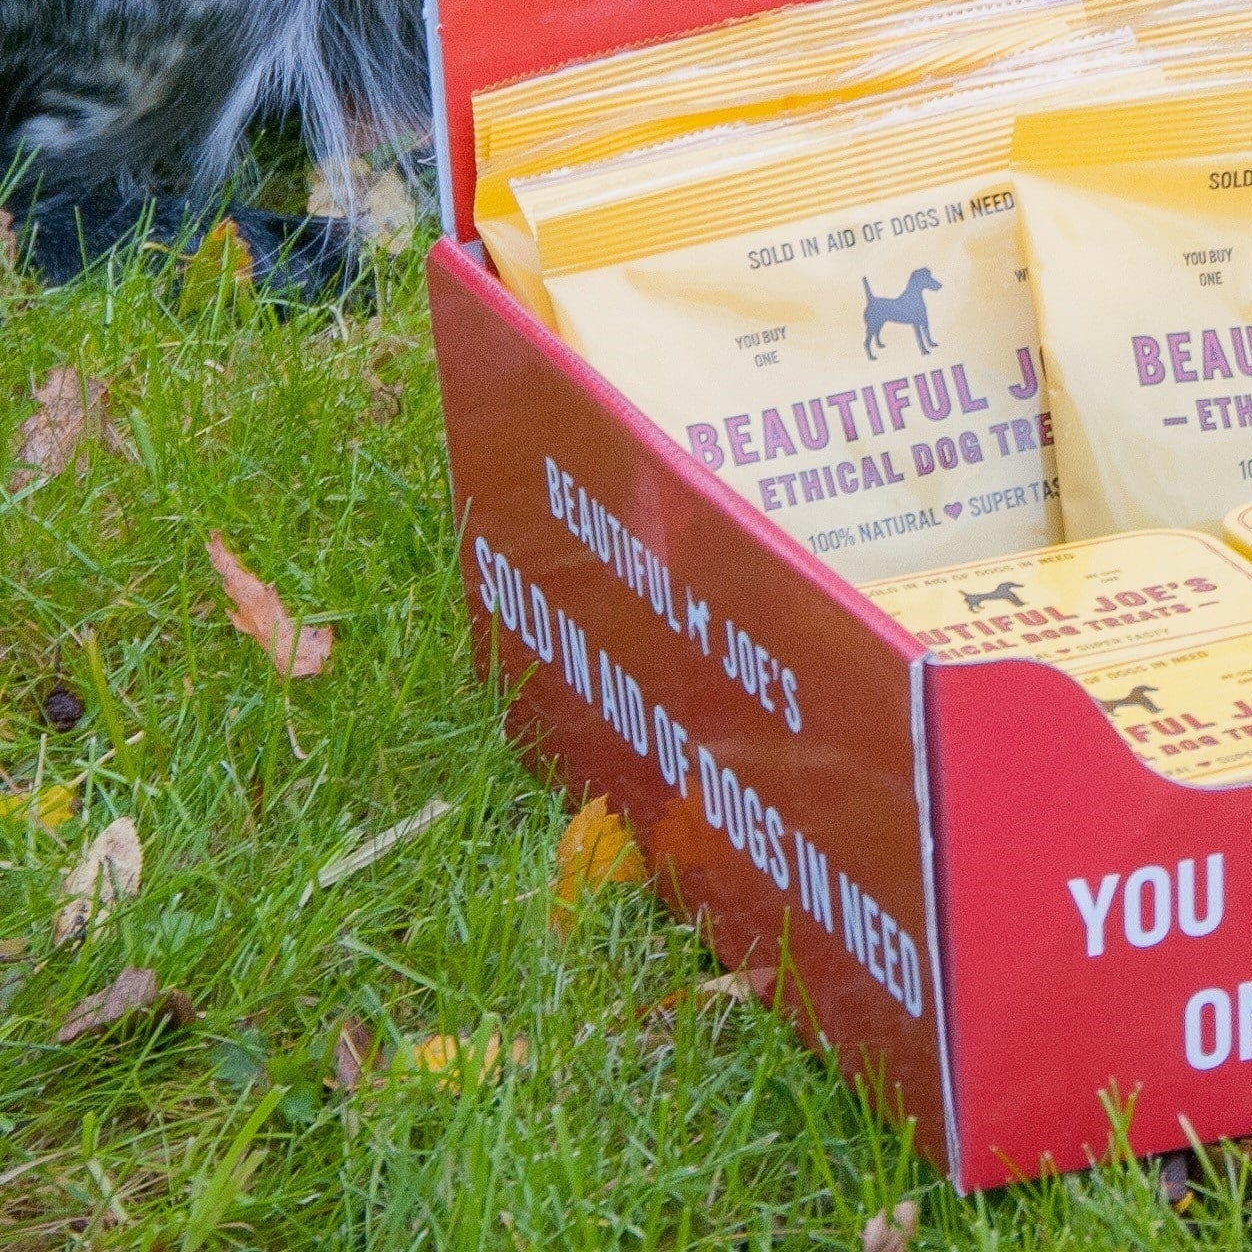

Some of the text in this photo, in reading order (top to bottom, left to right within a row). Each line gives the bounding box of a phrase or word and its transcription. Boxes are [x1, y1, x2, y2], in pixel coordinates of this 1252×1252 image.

[747, 190, 1016, 270] SOLD IN AID OF DOGS IN NEED
[1182, 247, 1234, 267] YOU BUY
[1198, 270, 1223, 287] ONE
[734, 326, 787, 351] YOU BUY
[754, 350, 780, 368] ONE
[685, 363, 989, 474] BEAUTIFUL
[757, 411, 1054, 512] ETHICAL DOG TRE
[807, 528, 855, 555] 100%
[858, 507, 942, 542] NATURAL
[968, 483, 1027, 517] SUPER
[543, 455, 801, 734] BEAUTIFUL JOE'S
[913, 604, 1078, 647] UTIFUL
[1093, 576, 1219, 613] JOE'S
[1020, 624, 1080, 644] DOG
[1084, 603, 1192, 632] TREATS
[473, 534, 923, 1020] SOLD IN AID OF DOGS IN NEED
[1158, 734, 1221, 756] DOG
[1066, 851, 1226, 959] YOU
